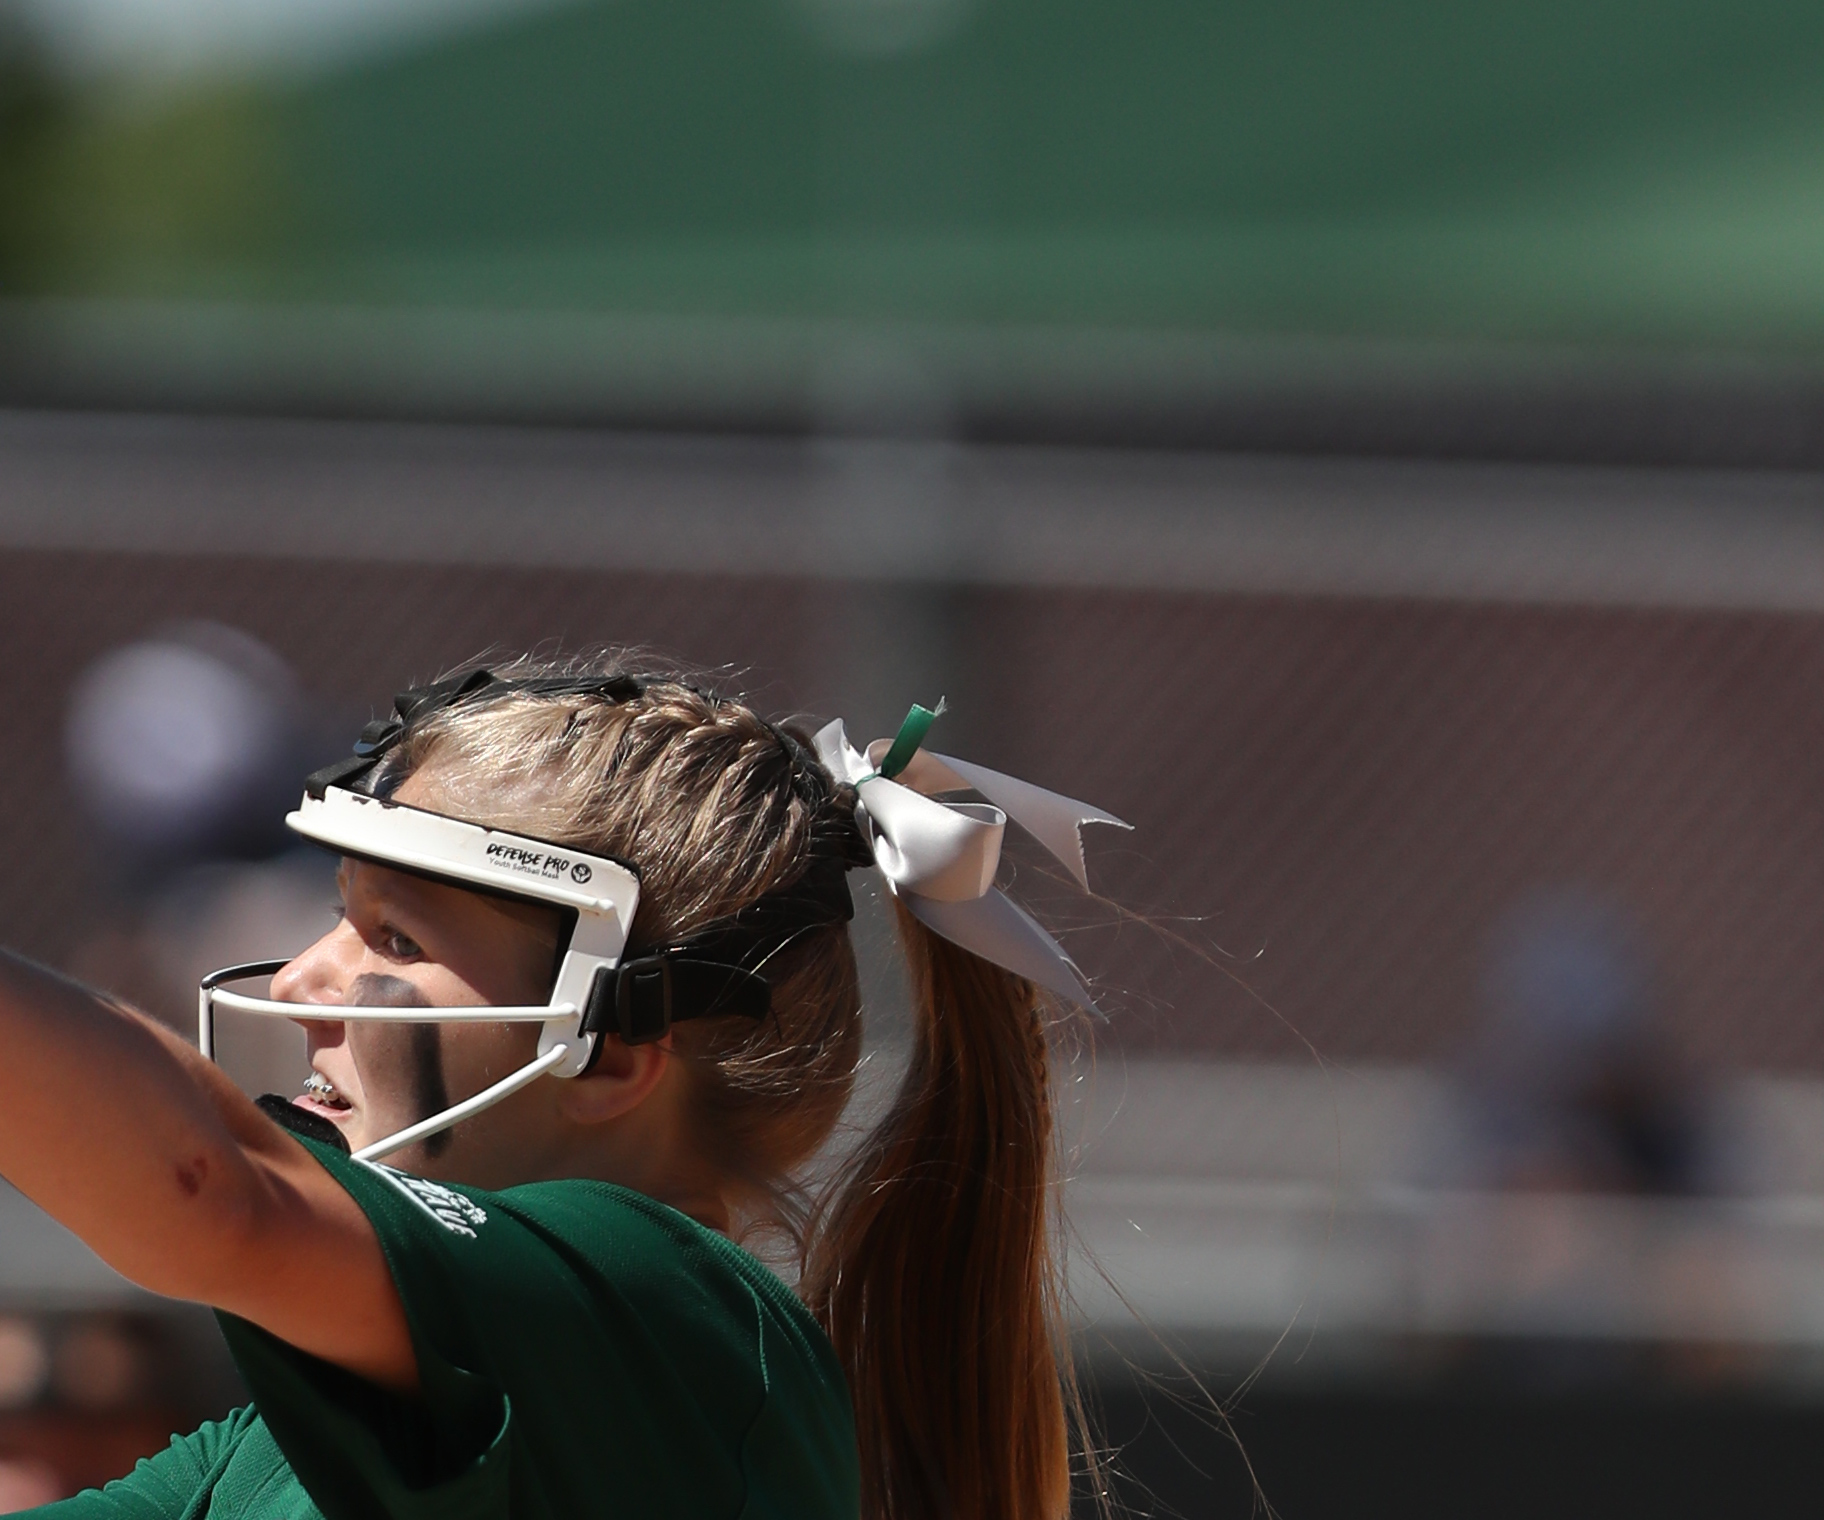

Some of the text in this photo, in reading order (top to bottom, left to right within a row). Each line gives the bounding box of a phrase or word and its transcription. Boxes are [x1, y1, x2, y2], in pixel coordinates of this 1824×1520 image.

[486, 843, 570, 874] DEFENSE PRO
[489, 857, 511, 868] Youth
